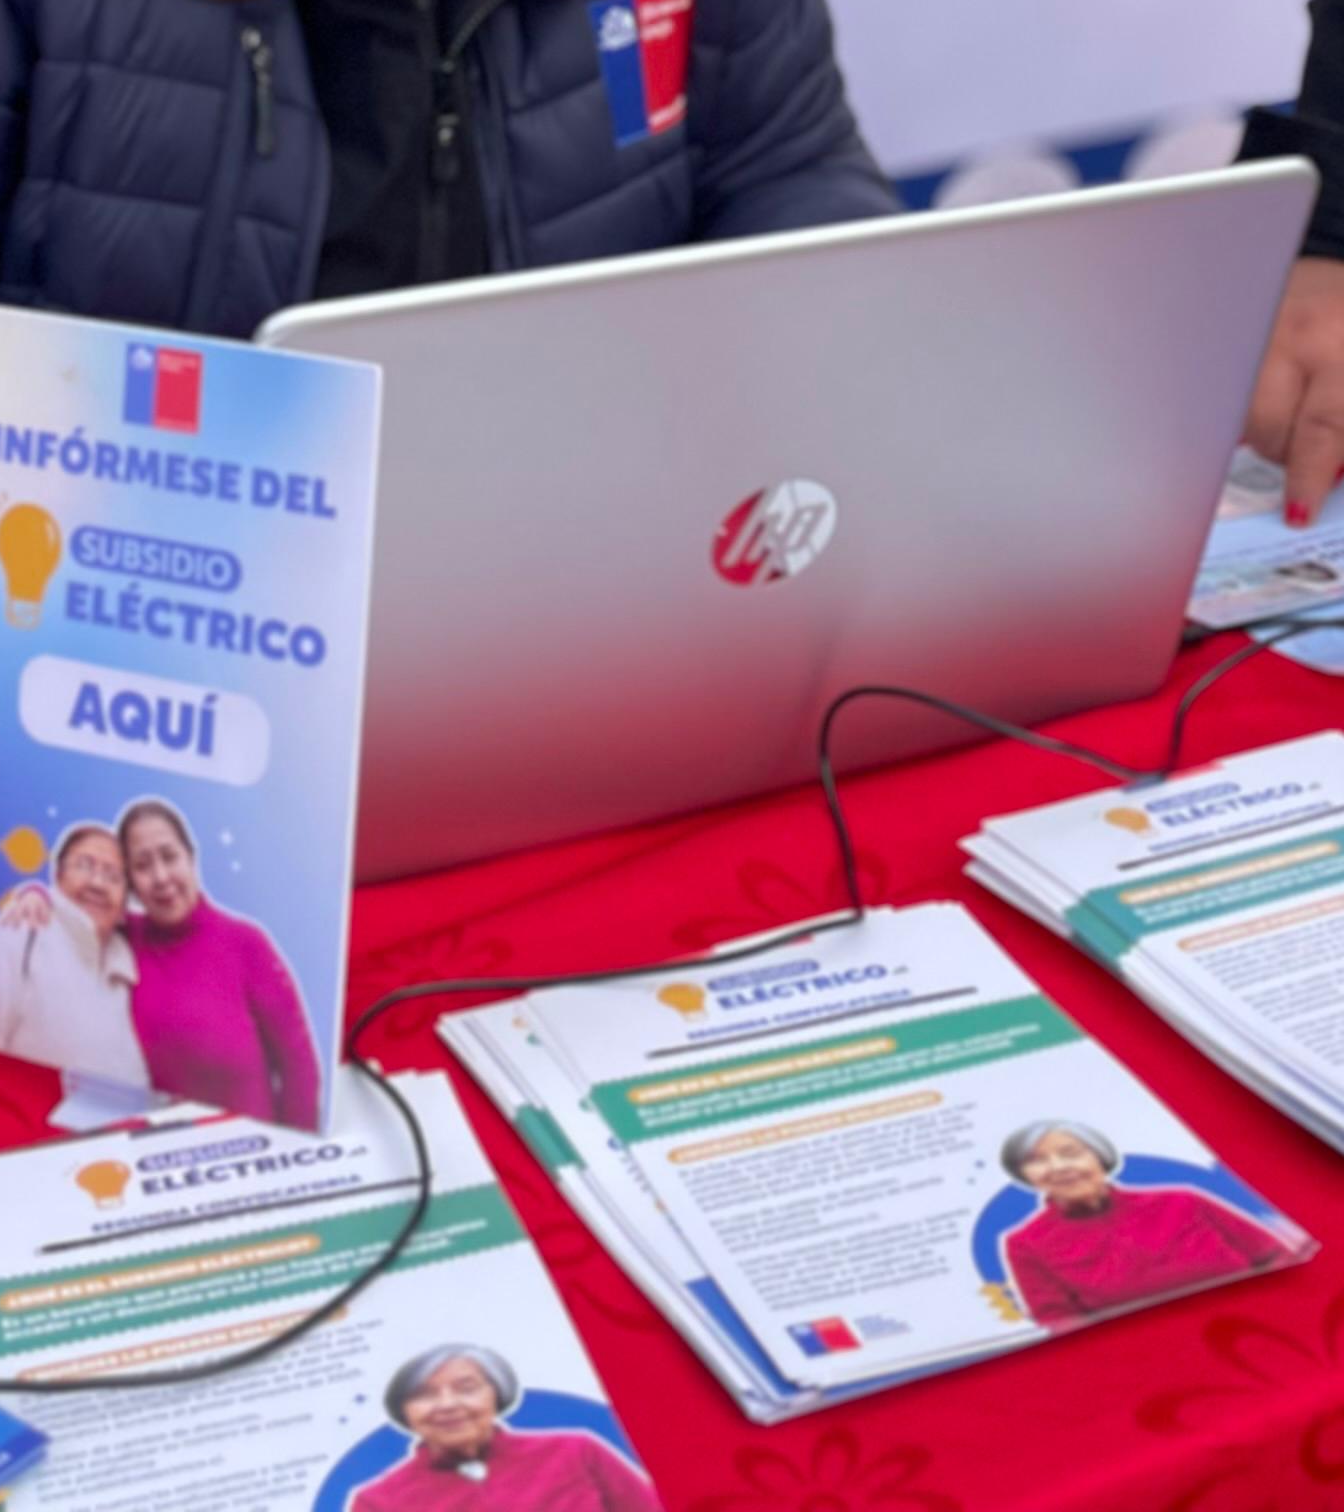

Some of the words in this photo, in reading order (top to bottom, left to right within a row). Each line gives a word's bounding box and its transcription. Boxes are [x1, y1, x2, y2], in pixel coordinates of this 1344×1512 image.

[250, 467, 337, 519] DEL
[77, 528, 235, 589] SUBSIDIO
[64, 581, 327, 667] ELÉCTRICO
[67, 681, 219, 757] AQUÍ
[141, 1143, 343, 1196] ELÉCTRICO
